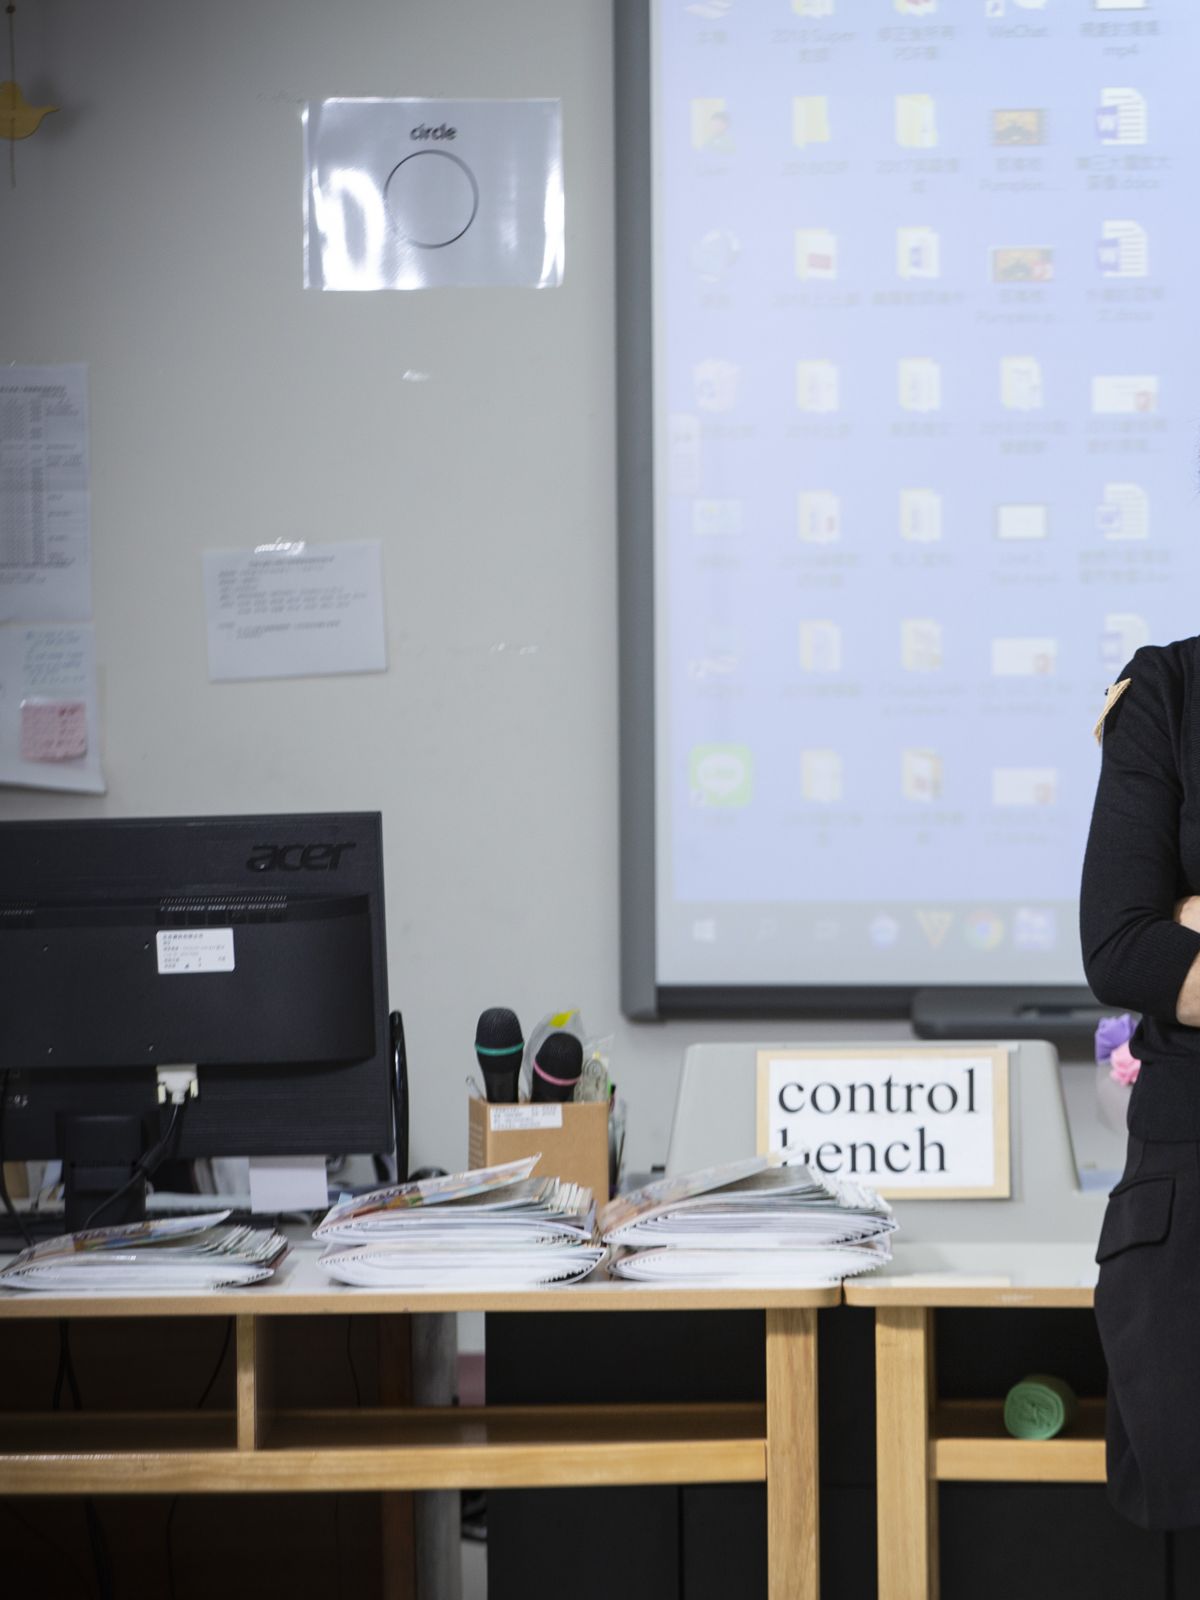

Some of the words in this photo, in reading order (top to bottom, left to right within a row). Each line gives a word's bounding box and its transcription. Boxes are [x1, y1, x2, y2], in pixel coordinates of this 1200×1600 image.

[410, 122, 458, 142] circle
[246, 841, 356, 873] acer
[778, 1068, 978, 1116] control
